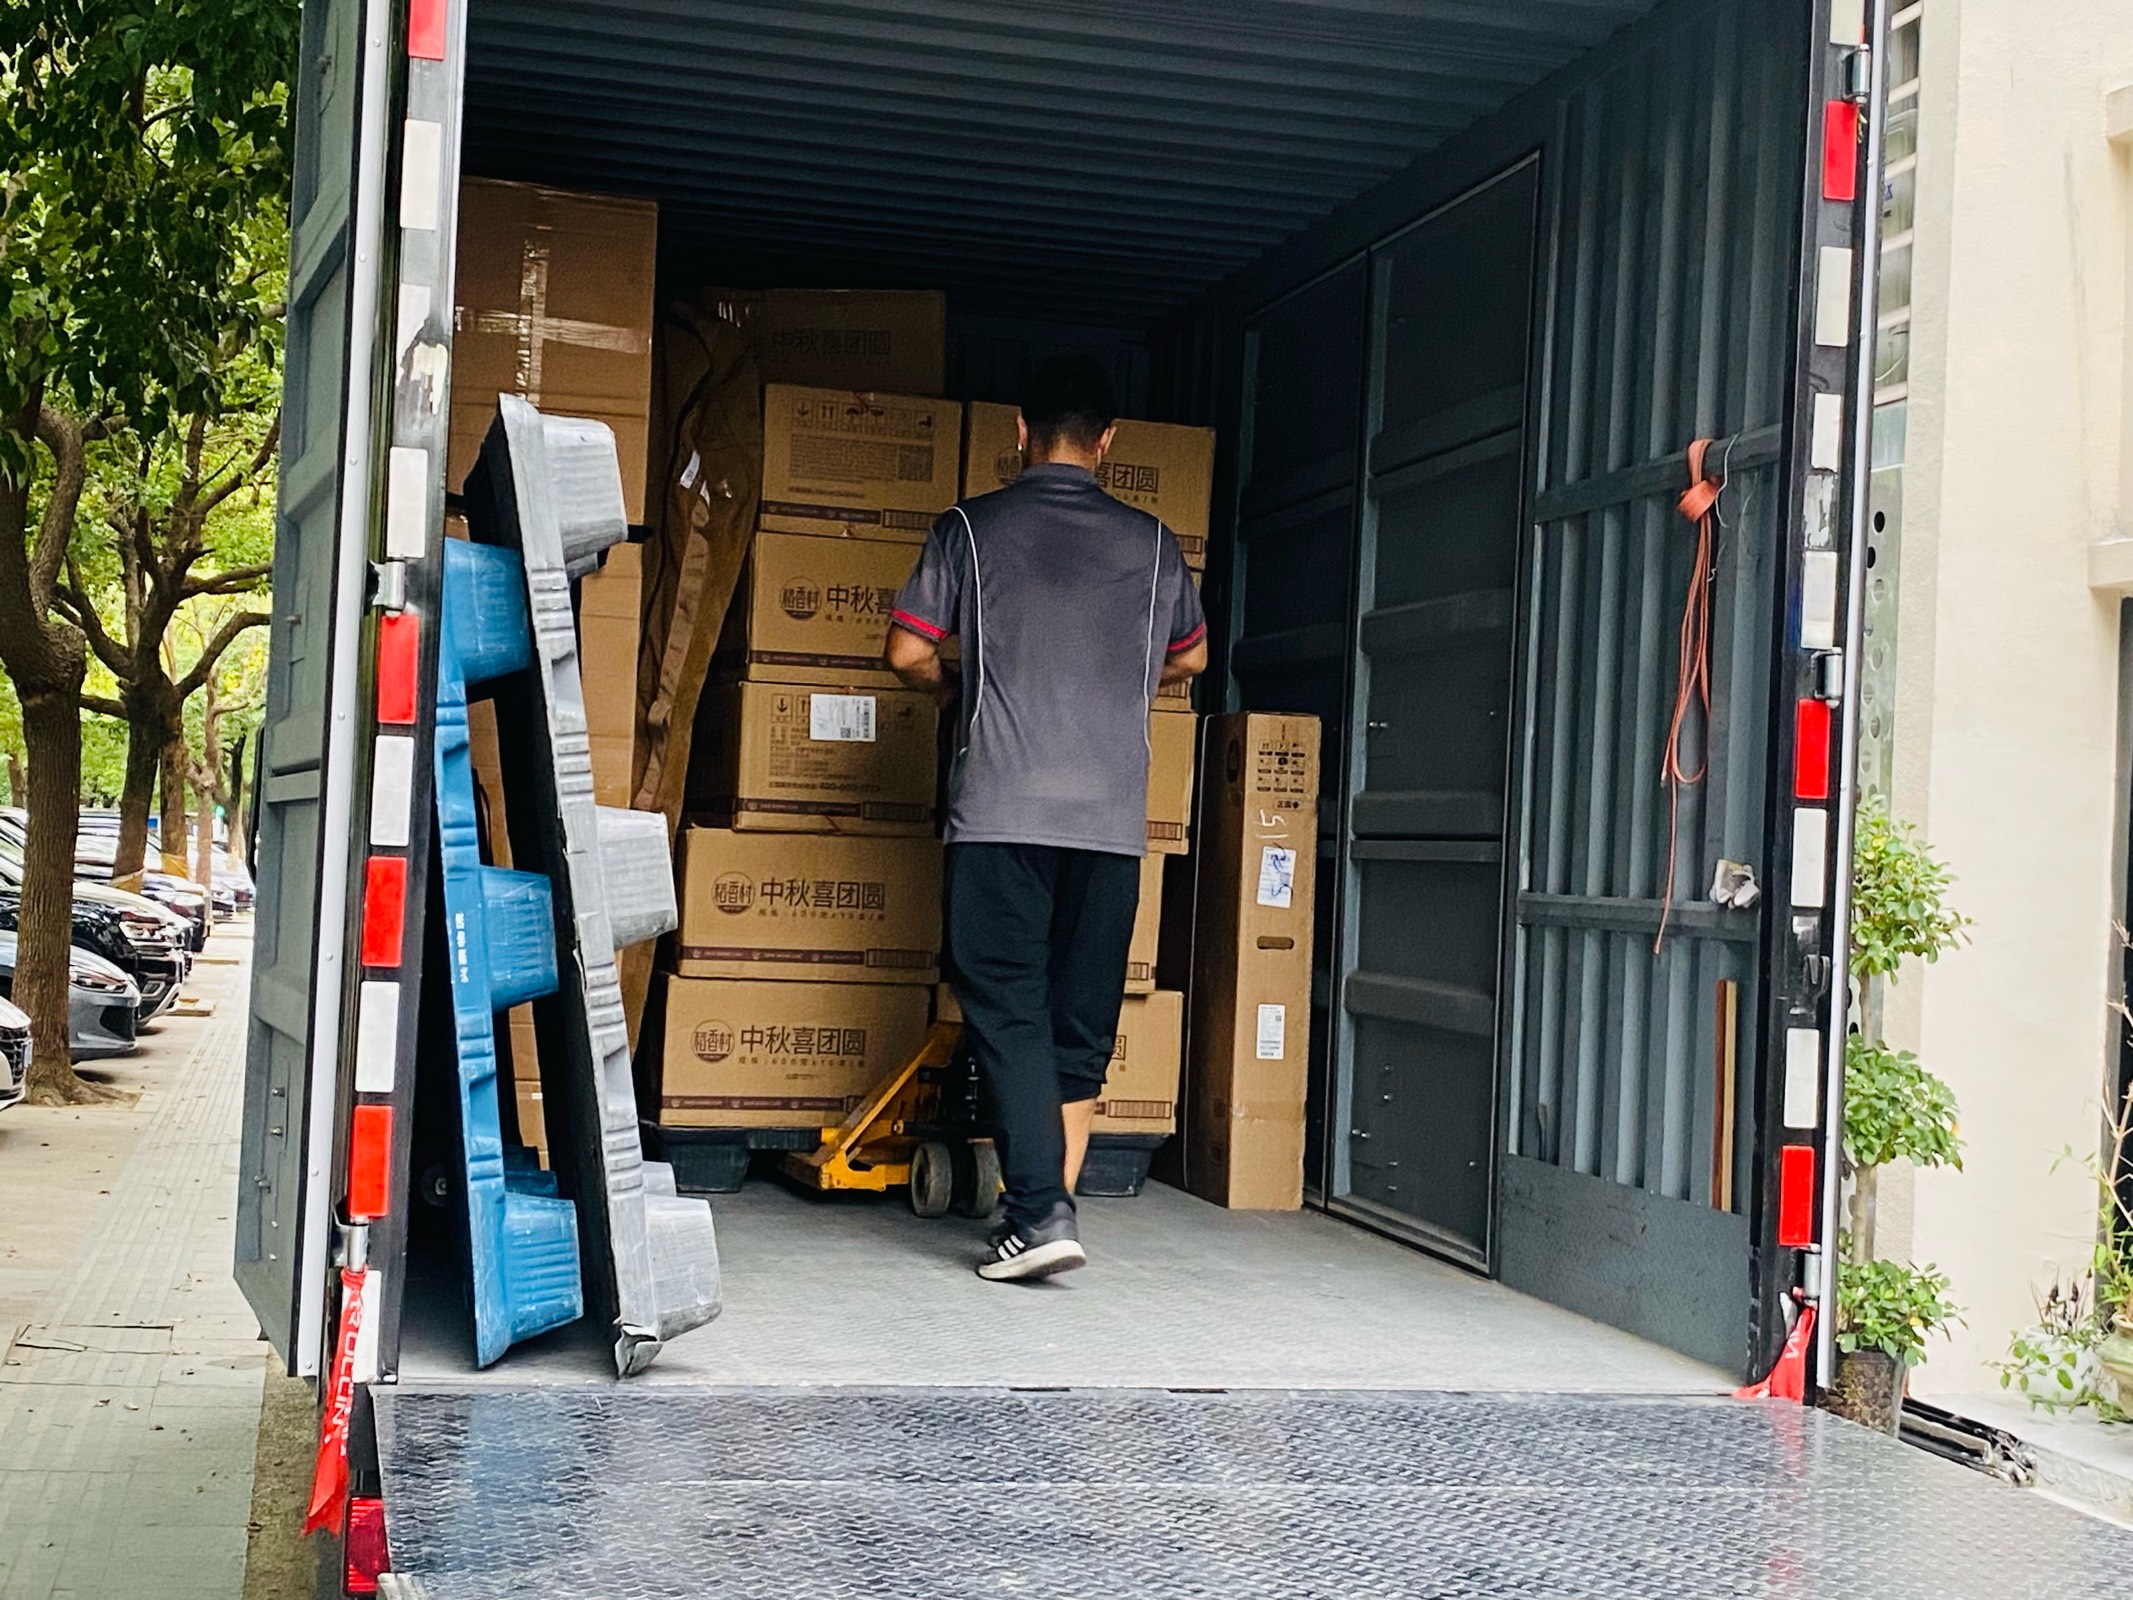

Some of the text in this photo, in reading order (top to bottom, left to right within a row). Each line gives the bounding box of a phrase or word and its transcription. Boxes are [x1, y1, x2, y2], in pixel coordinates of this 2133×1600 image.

[760, 876, 886, 911] 中秋喜团圆
[740, 1024, 867, 1057] 中秋喜团圆
